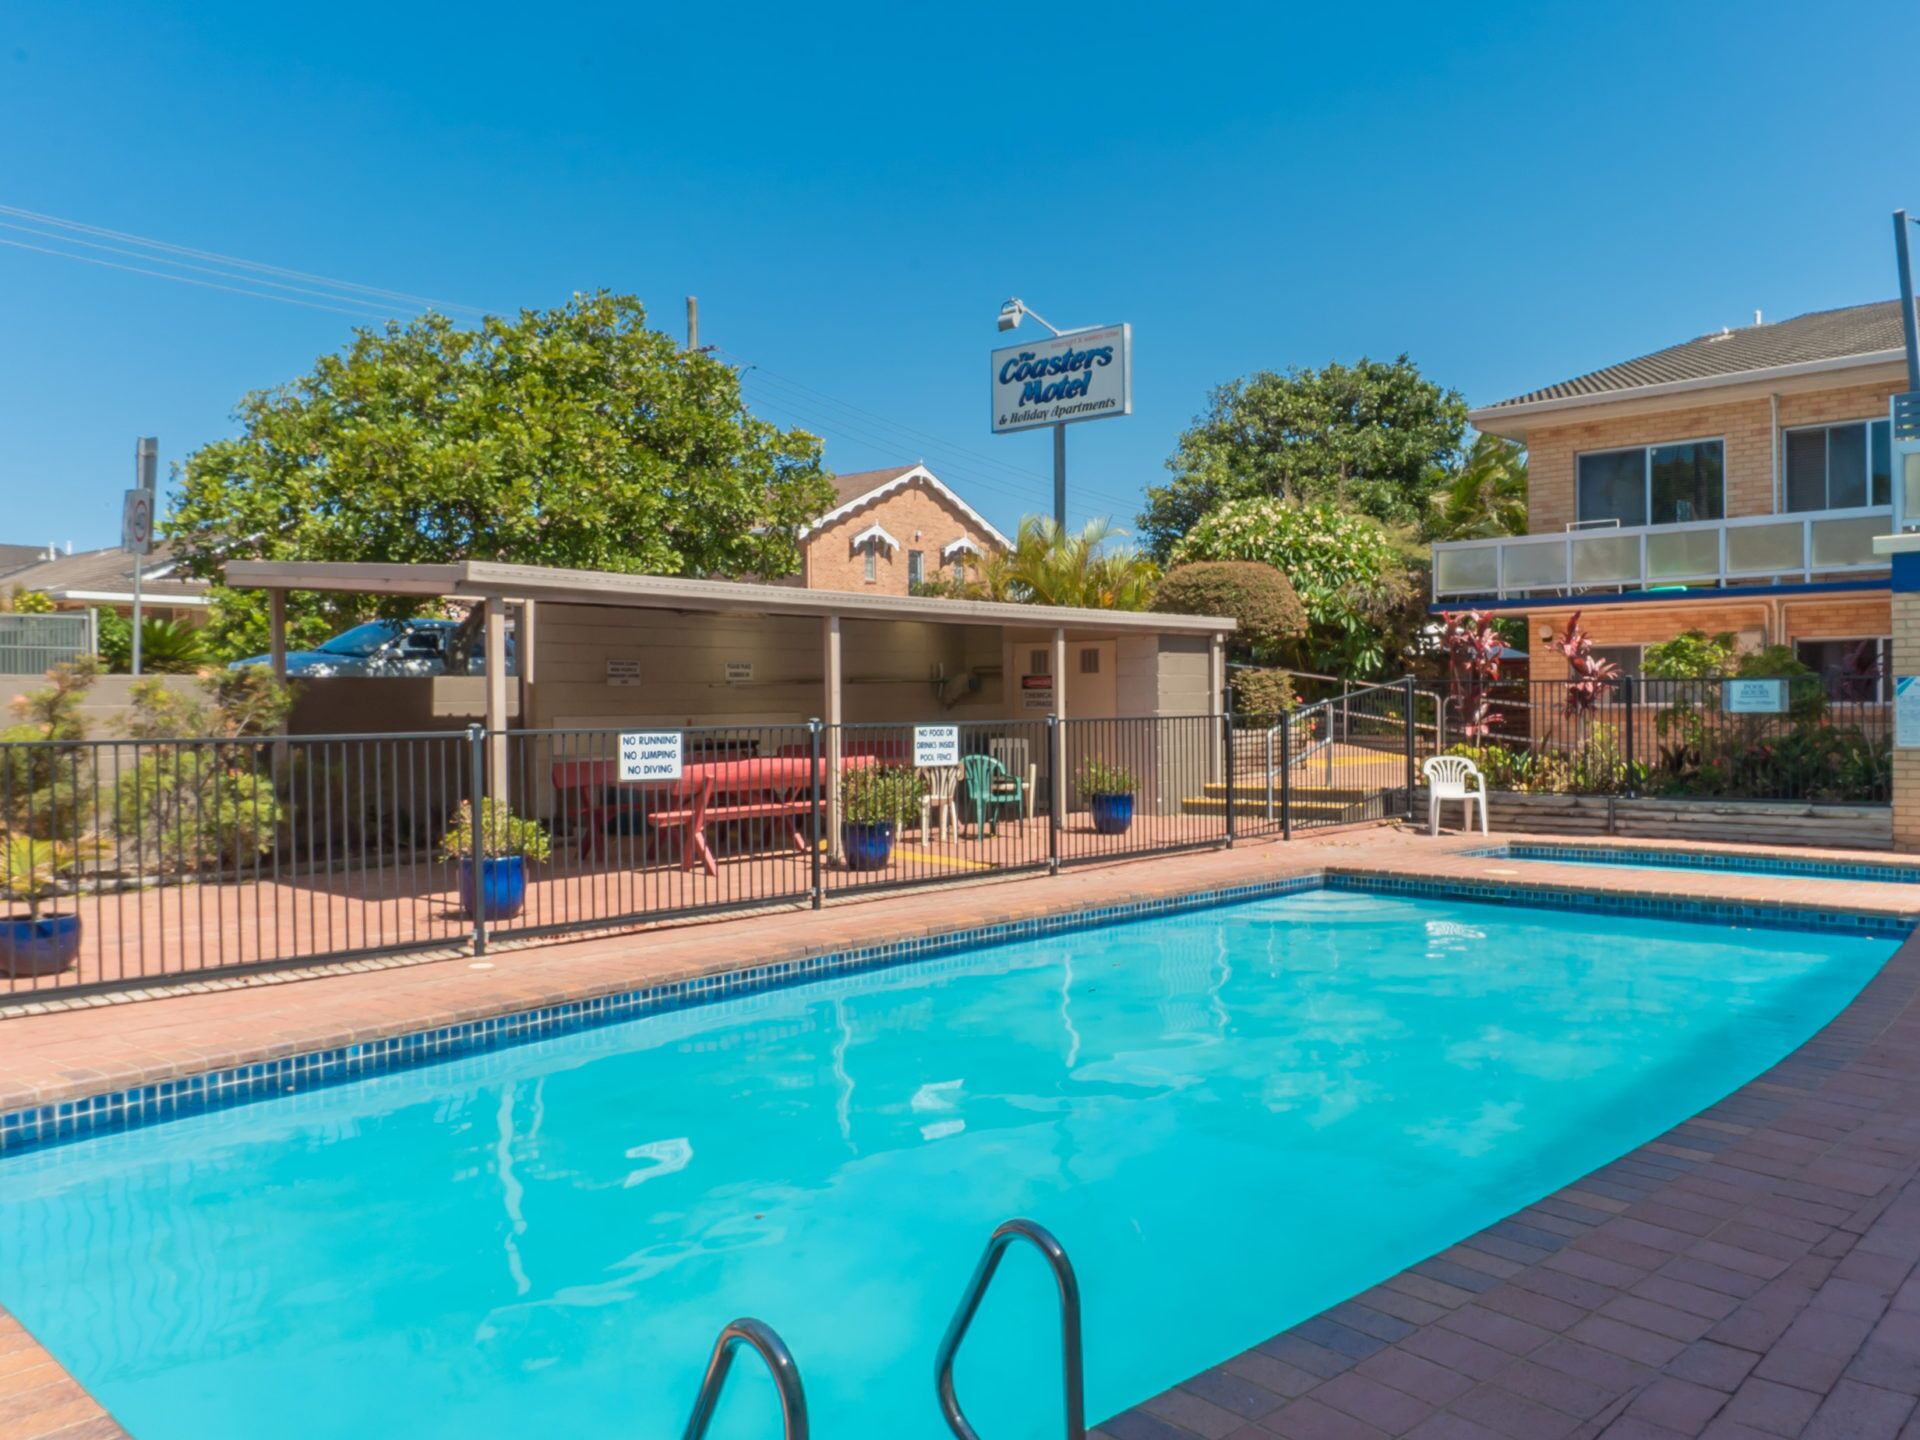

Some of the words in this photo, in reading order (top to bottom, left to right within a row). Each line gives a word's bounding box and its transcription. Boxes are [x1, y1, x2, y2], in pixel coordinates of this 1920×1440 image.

[999, 346, 1114, 385] Coasters
[1018, 370, 1092, 407] Motel
[998, 414, 1008, 425] &
[1010, 408, 1049, 425] Holiday
[1051, 397, 1116, 418] Apartments
[918, 729, 928, 737] NO
[929, 728, 945, 737] FOOD
[946, 728, 954, 737] OR
[622, 736, 636, 746] NO
[638, 735, 678, 745] RUNNING
[916, 741, 938, 750] DRINKS
[939, 740, 955, 749] INSIDE
[623, 751, 637, 760] NO
[640, 750, 677, 760] JUMPING
[920, 753, 935, 762] POOL
[936, 752, 952, 761] FENCE
[627, 765, 641, 775] NO
[643, 764, 673, 774] DIVING
